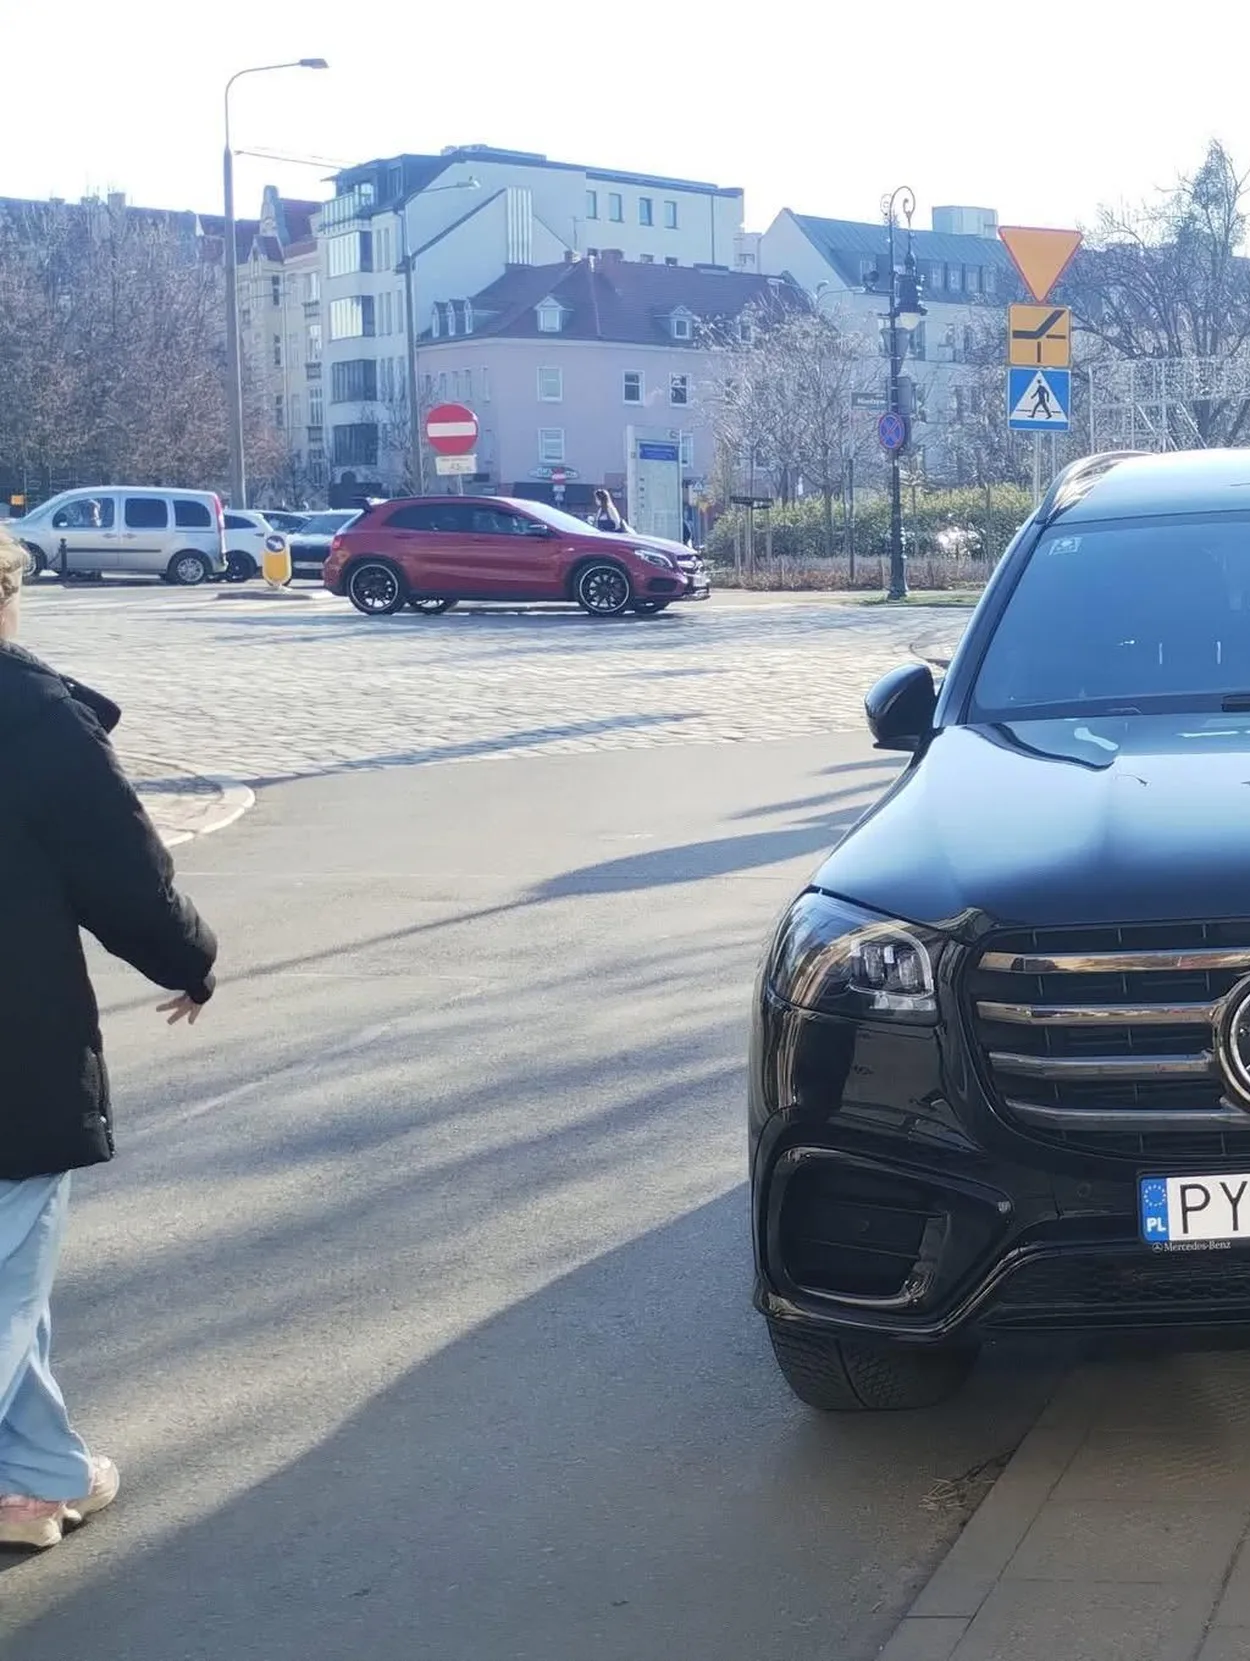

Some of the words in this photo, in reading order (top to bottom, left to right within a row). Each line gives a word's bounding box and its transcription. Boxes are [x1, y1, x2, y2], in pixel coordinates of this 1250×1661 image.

[1180, 1181, 1248, 1234] PY
[1146, 1216, 1167, 1232] PL
[1163, 1241, 1232, 1252] Mercedes-Benz
